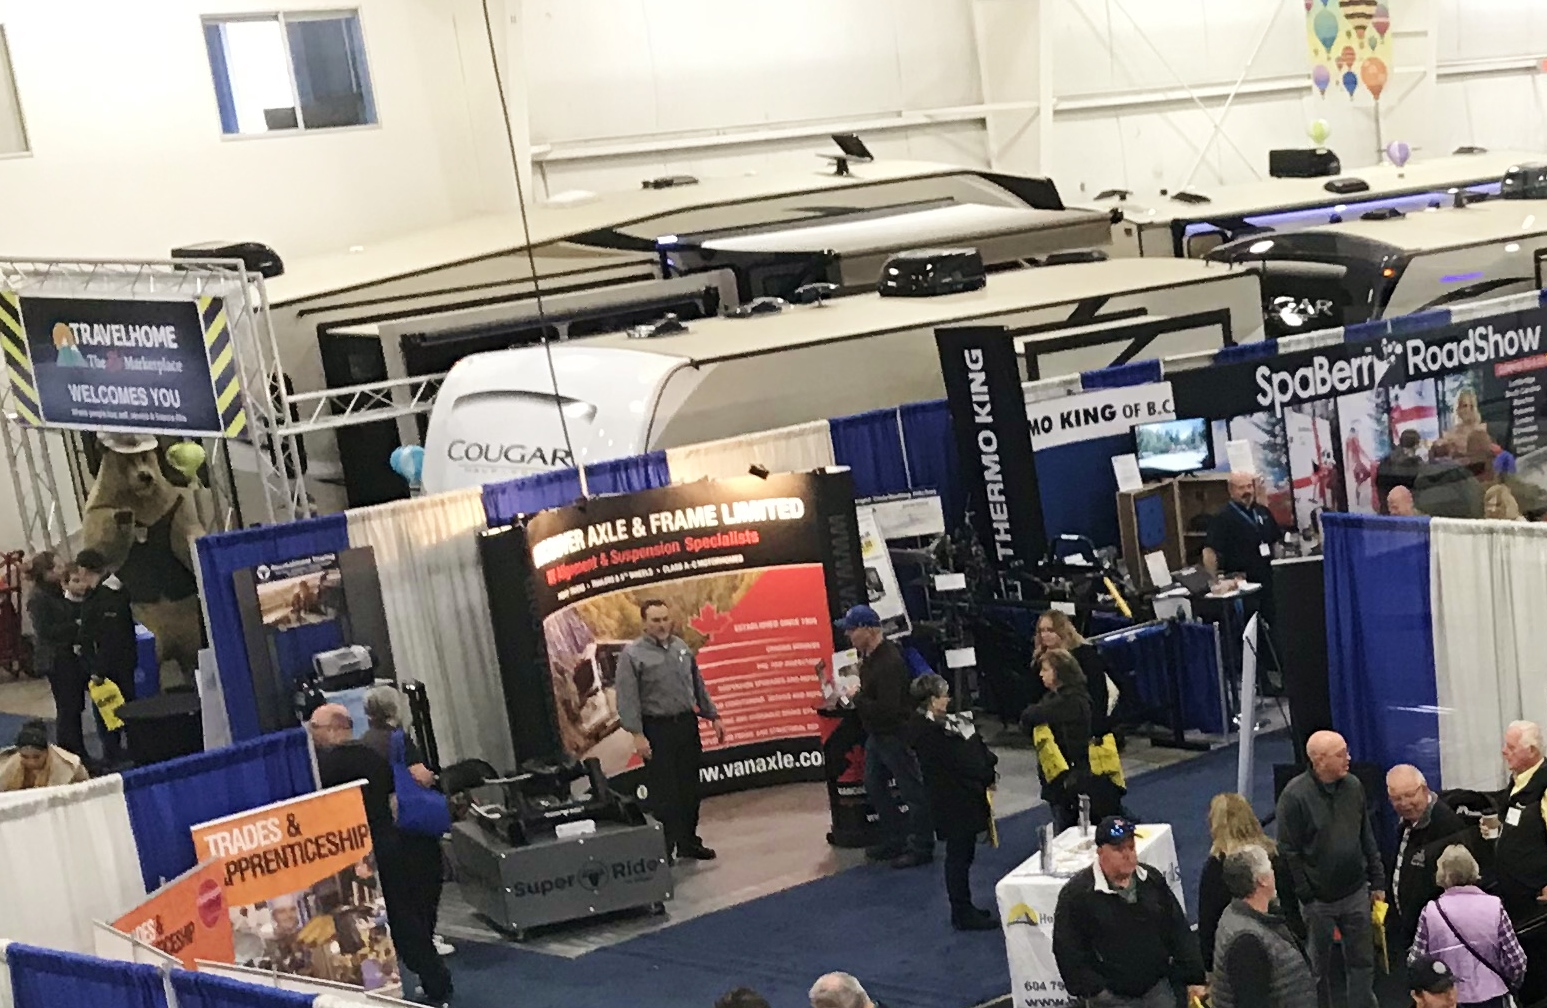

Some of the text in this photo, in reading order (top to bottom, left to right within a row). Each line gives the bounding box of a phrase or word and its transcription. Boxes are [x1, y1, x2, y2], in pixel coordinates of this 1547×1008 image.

[68, 322, 179, 349] TRAVELHOME
[1406, 324, 1543, 376] RoadShow
[87, 354, 183, 374] The Marketplace
[68, 384, 181, 408] WELCOMES YOU
[1060, 403, 1117, 431] KING
[1122, 401, 1142, 420] OF
[448, 439, 573, 467] COUGAR
[963, 348, 1015, 562] THERMO KING
[588, 498, 805, 547] AXLE & FRAME LIMITED
[610, 539, 680, 567] Suspension
[684, 529, 761, 555] Specialists
[700, 749, 825, 783] w.vanaxle.co
[204, 813, 301, 858] TRADES &
[224, 823, 369, 887] PPRENTICESHIP
[514, 872, 575, 898] Super
[1024, 982, 1047, 992] 604
